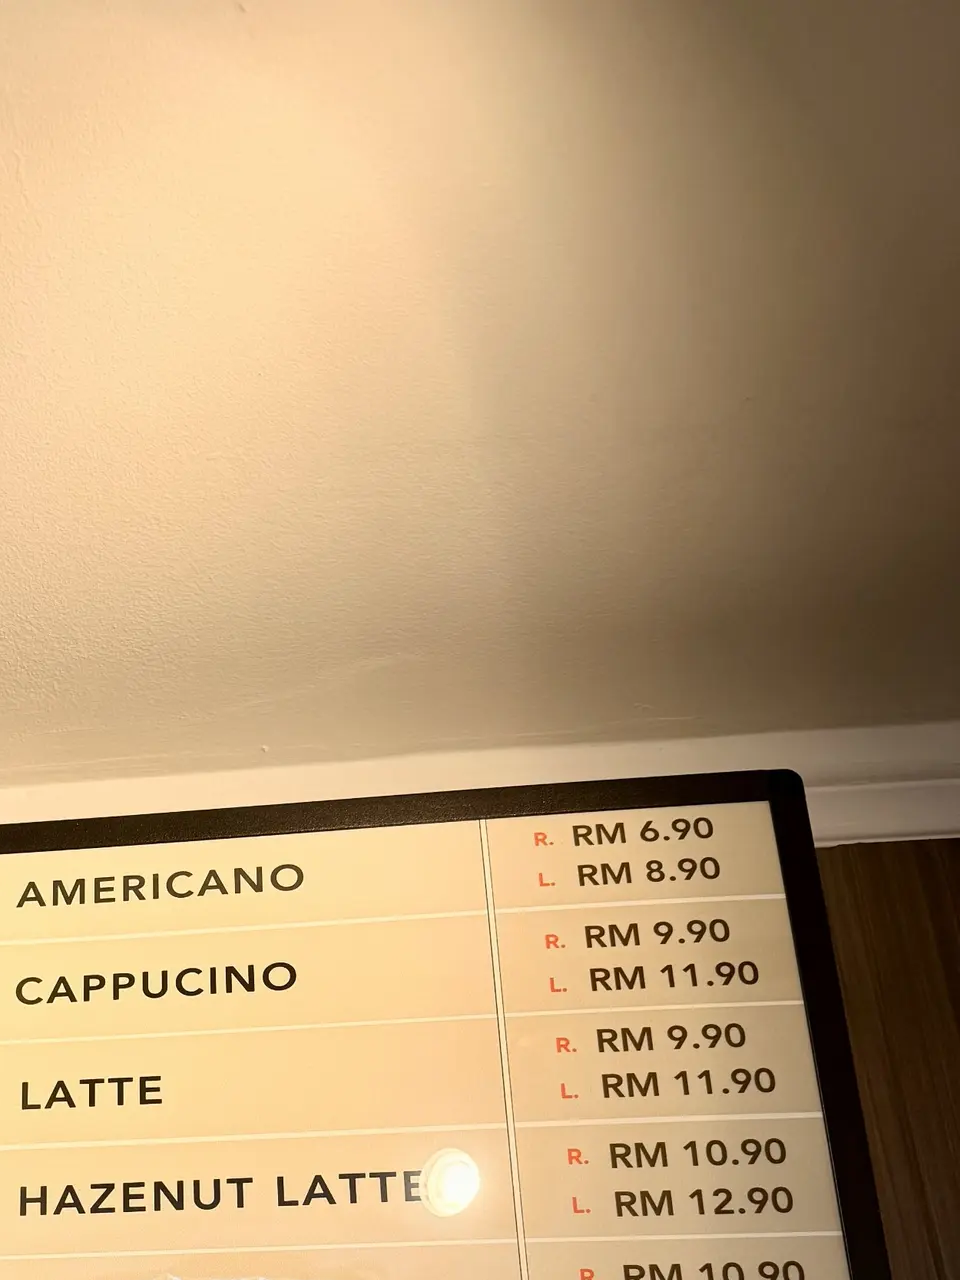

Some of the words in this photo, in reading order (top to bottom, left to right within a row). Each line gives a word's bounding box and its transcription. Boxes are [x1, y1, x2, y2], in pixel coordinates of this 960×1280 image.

[534, 832, 554, 846] R.
[572, 823, 627, 846] RM
[639, 817, 714, 842] 6.90
[16, 864, 304, 907] AMERICANO
[539, 873, 556, 887] L.
[577, 862, 632, 886] RM
[645, 857, 721, 882] 8.90
[545, 934, 566, 949] R.
[584, 924, 640, 949] RM
[653, 919, 730, 944] 9.90
[15, 963, 297, 1005] CAPPUCINO
[550, 978, 567, 993] L.
[589, 966, 646, 992] RM
[660, 961, 759, 987] 11.90
[556, 1037, 577, 1052] R.
[596, 1027, 653, 1052] RM
[667, 1023, 746, 1050] 9.90
[21, 1076, 162, 1109] LATTE
[560, 1083, 578, 1099] L.
[601, 1072, 659, 1098] RM
[674, 1068, 776, 1095] 11.90
[567, 1149, 589, 1165] R.
[609, 1142, 668, 1168] RM
[683, 1138, 786, 1166] 10.90
[19, 1178, 253, 1216] HAZENUT
[276, 1171, 421, 1207] LATTE
[572, 1197, 591, 1213] L.
[614, 1191, 674, 1217] RM
[689, 1187, 793, 1215] 12.90
